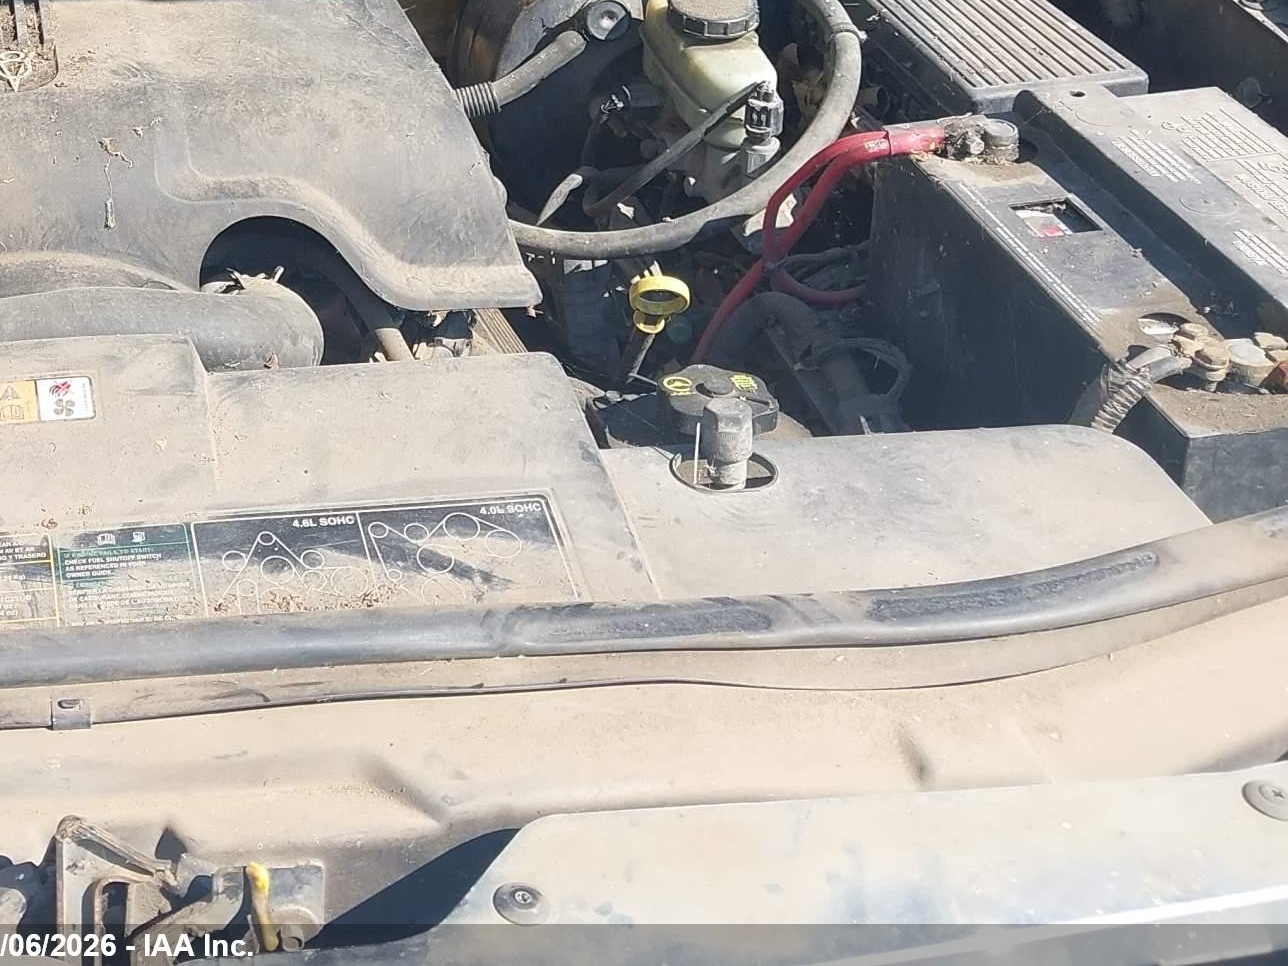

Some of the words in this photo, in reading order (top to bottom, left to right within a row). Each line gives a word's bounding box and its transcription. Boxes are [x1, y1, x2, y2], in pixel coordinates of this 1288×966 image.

[480, 506, 504, 515] 4.0L
[506, 502, 541, 514] SOHC
[292, 519, 317, 528] 4.6L
[319, 516, 354, 526] SOHC
[106, 555, 136, 563] SHUTOFF
[76, 562, 118, 572] REFERENCED
